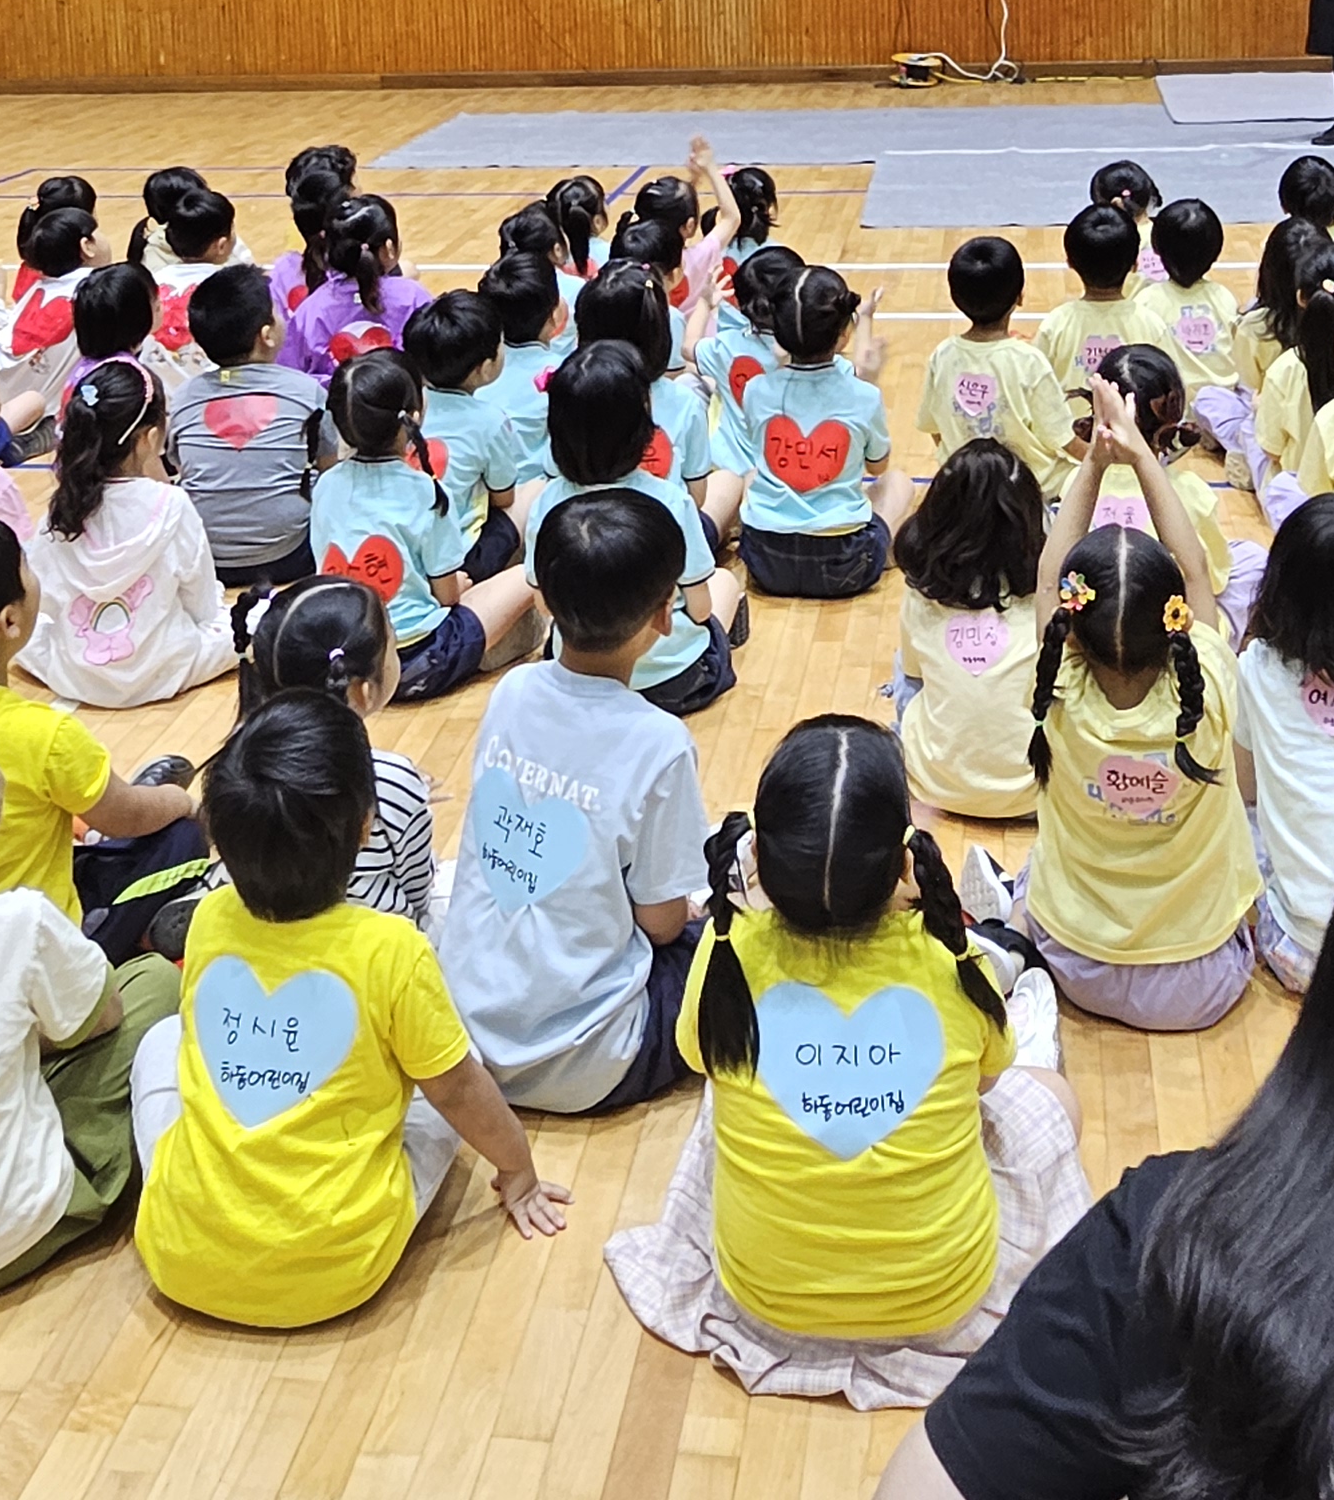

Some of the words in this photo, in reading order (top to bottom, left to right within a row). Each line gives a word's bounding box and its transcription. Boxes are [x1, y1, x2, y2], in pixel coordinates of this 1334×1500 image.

[771, 436, 838, 470] 강민서
[1107, 769, 1169, 795] 황예슬
[493, 805, 547, 859] 곽재호
[223, 1007, 300, 1052] 정시윤
[795, 1042, 901, 1067] 이지아
[221, 1061, 311, 1094] 하동어린이집
[801, 1089, 905, 1122] 하동어린이집
